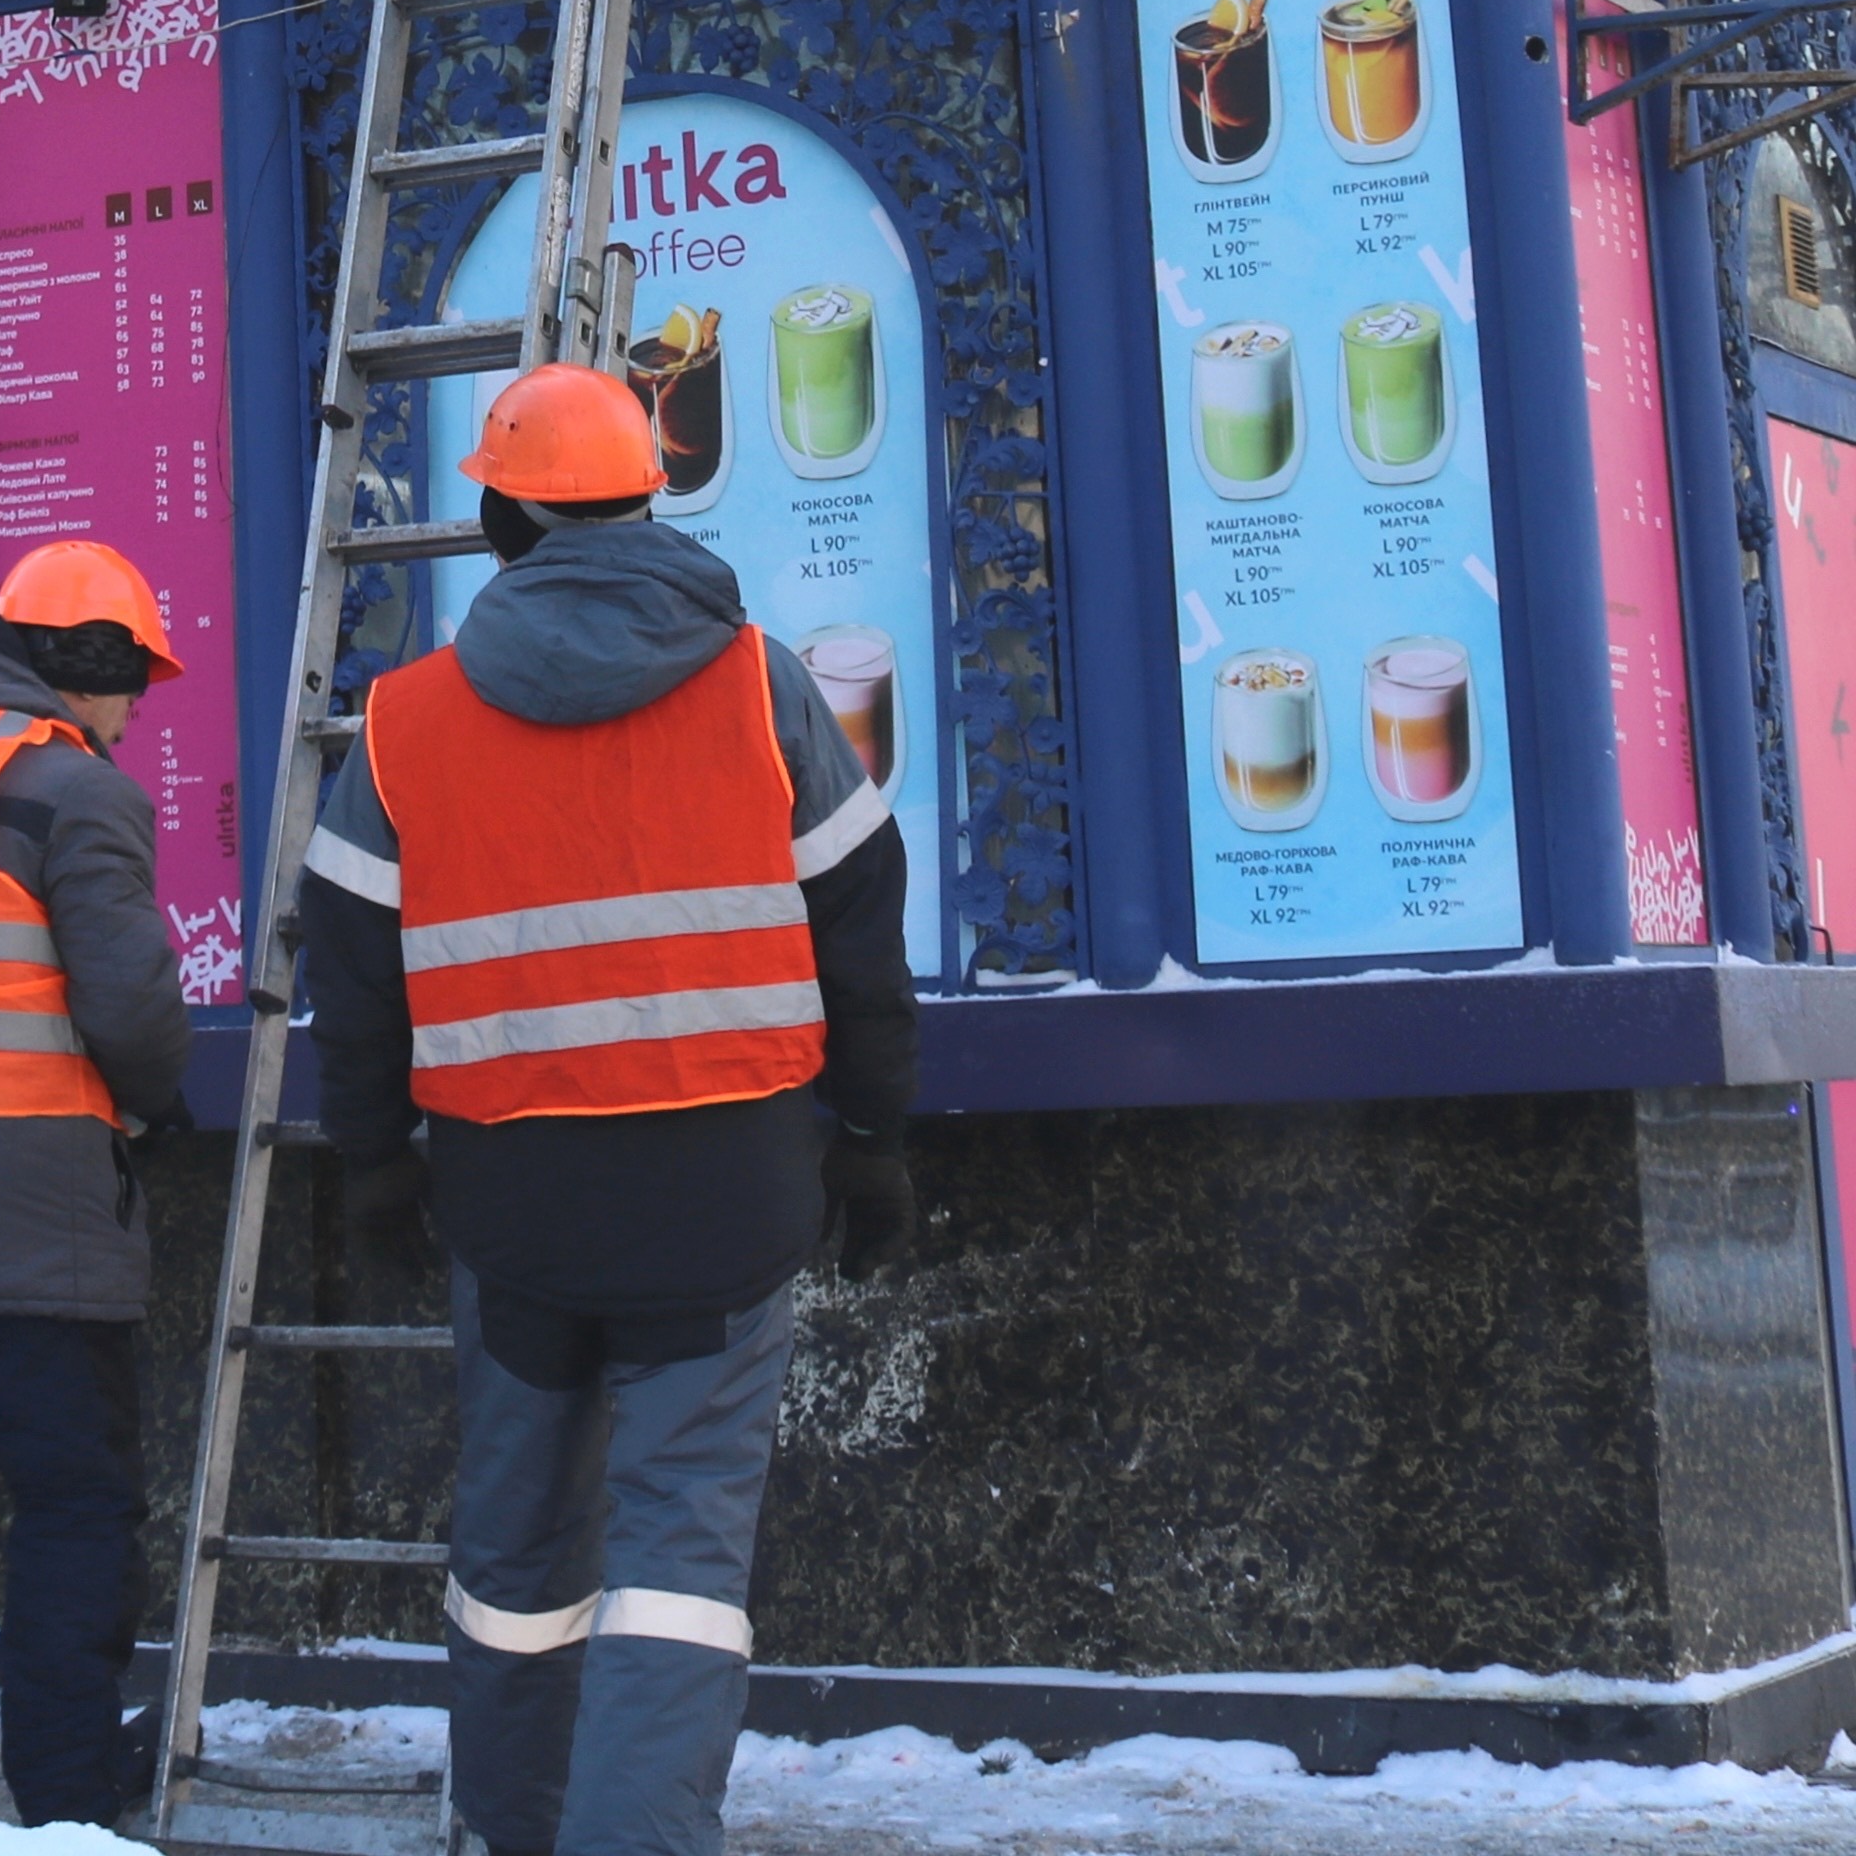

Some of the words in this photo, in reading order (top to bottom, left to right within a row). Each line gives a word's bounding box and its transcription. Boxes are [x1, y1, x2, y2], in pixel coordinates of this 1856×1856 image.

[1333, 171, 1430, 195] ПЕРСИКОВИЙ
[1194, 194, 1271, 213] ГЛІНТВЕЙН
[1360, 192, 1404, 206] ПУНШ
[49, 217, 84, 233] НАПОЇ
[114, 211, 125, 223] M
[155, 206, 162, 217] L
[194, 200, 208, 211] XL
[1360, 217, 1369, 231] L
[1207, 221, 1222, 237] M
[114, 235, 126, 247] 35
[1356, 239, 1377, 254] XL
[114, 250, 127, 262] 38
[1212, 244, 1222, 258] L
[56, 271, 101, 284] молоком
[115, 267, 127, 278] 45
[1203, 266, 1224, 281] XL
[19, 294, 42, 307] Уайт
[115, 300, 128, 311] 52
[150, 294, 162, 305] 64
[190, 289, 202, 301] 72
[116, 316, 128, 327] 52
[150, 310, 163, 321] 64
[191, 306, 203, 317] 72
[152, 327, 165, 339] 75
[116, 348, 128, 359] 57
[35, 370, 78, 385] шоколад
[117, 364, 130, 375] 63
[151, 360, 164, 371] 73
[29, 390, 53, 400] Кава
[152, 377, 164, 388] 73
[192, 371, 205, 383] 90
[35, 457, 66, 468] Какао
[155, 446, 168, 457] 73
[42, 472, 67, 485] Лате
[155, 462, 168, 473] 74
[47, 487, 94, 501] капучино
[155, 479, 167, 490] 74
[18, 507, 50, 519] Бейліз
[156, 495, 168, 506] 74
[792, 493, 874, 513] КОКОСОВА
[1363, 498, 1444, 515] КОКОСОВА
[59, 519, 91, 532] Мокко
[156, 511, 168, 523] 74
[807, 511, 859, 527] МАТЧА
[1206, 512, 1303, 531] КАШТАНОВО-
[1379, 515, 1430, 529] МАТЧА
[1211, 528, 1301, 546] МИГДАЛЬНА
[811, 538, 820, 554] L
[1232, 545, 1281, 558] МАТЧА
[1383, 539, 1392, 554] L
[800, 563, 823, 579] XL
[1235, 568, 1243, 583] L
[1373, 562, 1395, 578] XL
[157, 589, 170, 601] 45
[1225, 591, 1246, 606] XL
[197, 615, 211, 629] 95
[1381, 837, 1476, 853] ПОЛУНИЧНА
[1216, 845, 1337, 863] МЕДОВО-ГОРІХОВА
[1392, 853, 1467, 868] РАФ-КАВА
[1240, 863, 1313, 877] РАФ-КАВА
[1255, 886, 1265, 901] L
[1407, 878, 1417, 893] L
[1250, 909, 1272, 925] XL
[1402, 901, 1425, 917] XL
